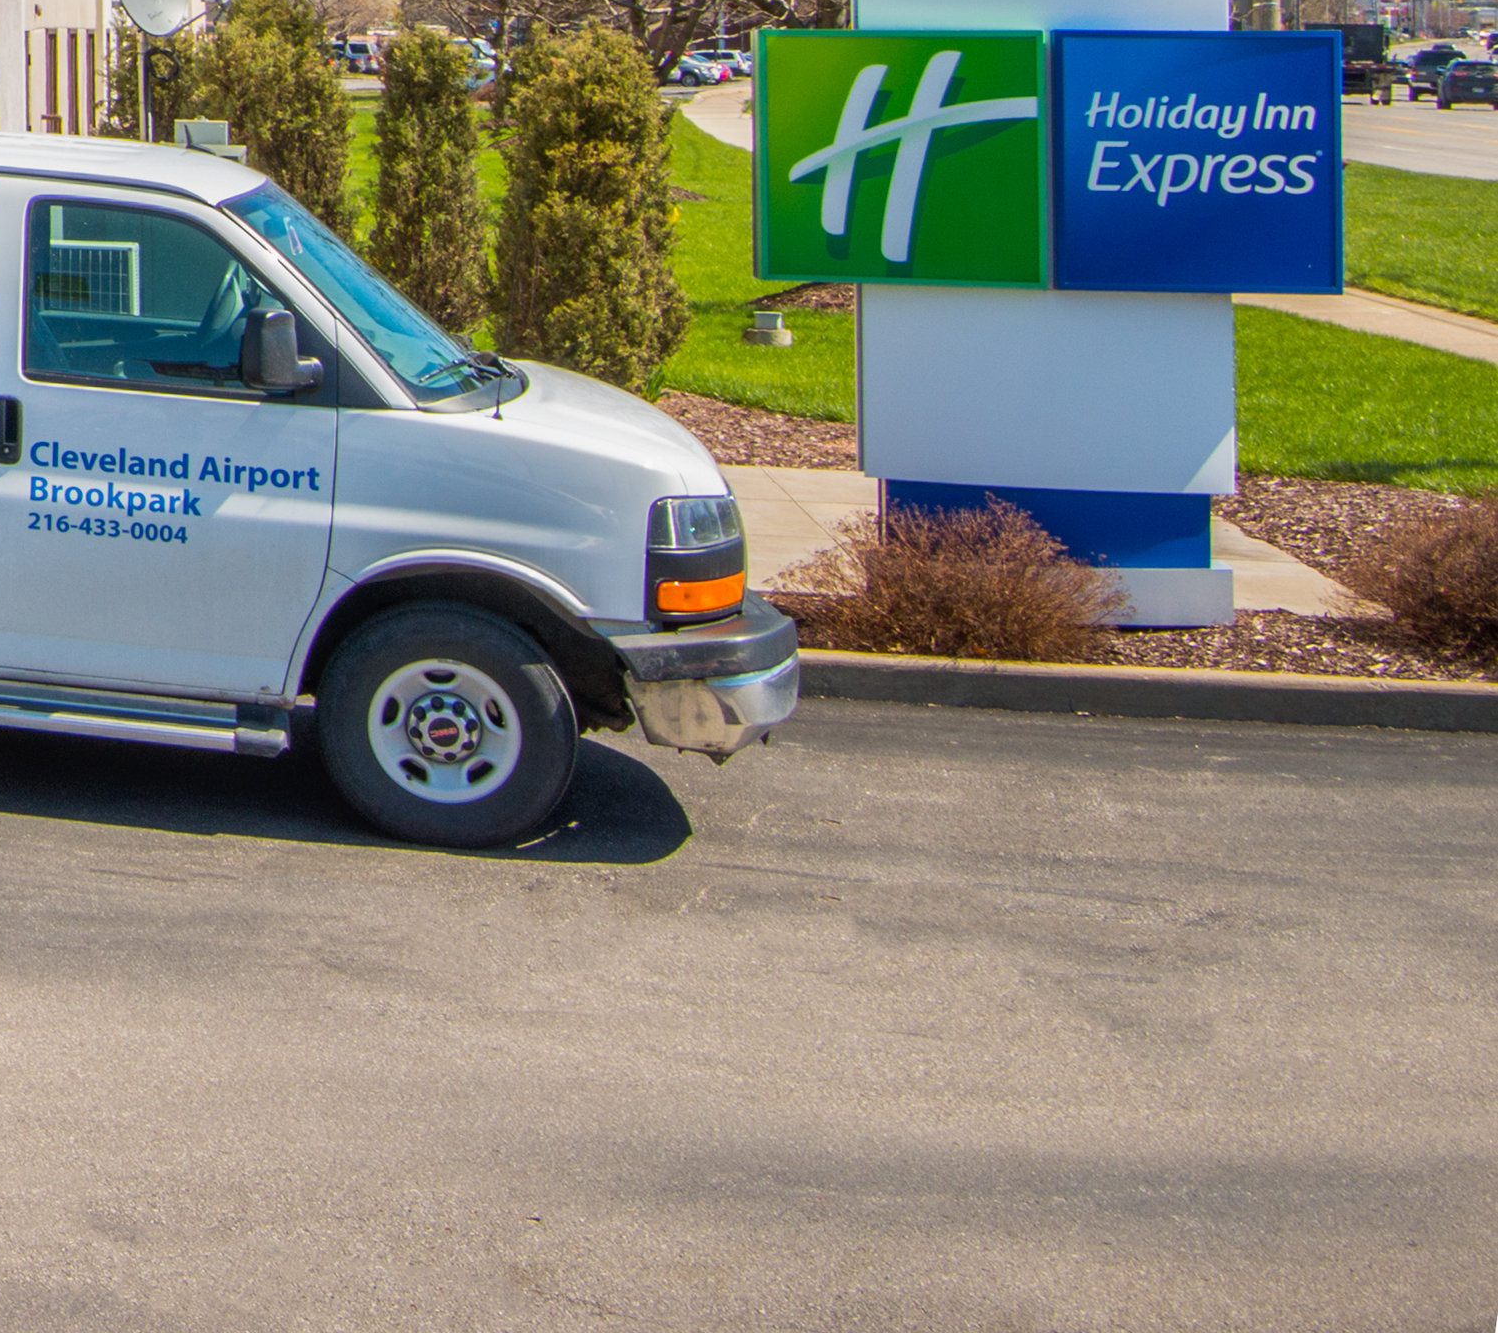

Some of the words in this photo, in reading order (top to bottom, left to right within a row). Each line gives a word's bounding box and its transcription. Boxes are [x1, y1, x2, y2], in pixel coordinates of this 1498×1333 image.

[1084, 90, 1248, 139] Holiday
[1253, 92, 1317, 131] Inn
[1086, 140, 1318, 207] Express
[29, 441, 190, 480] Cleveland
[198, 456, 320, 492] Airport
[29, 476, 202, 517] Brookpark
[27, 512, 188, 544] 216-433-0004
